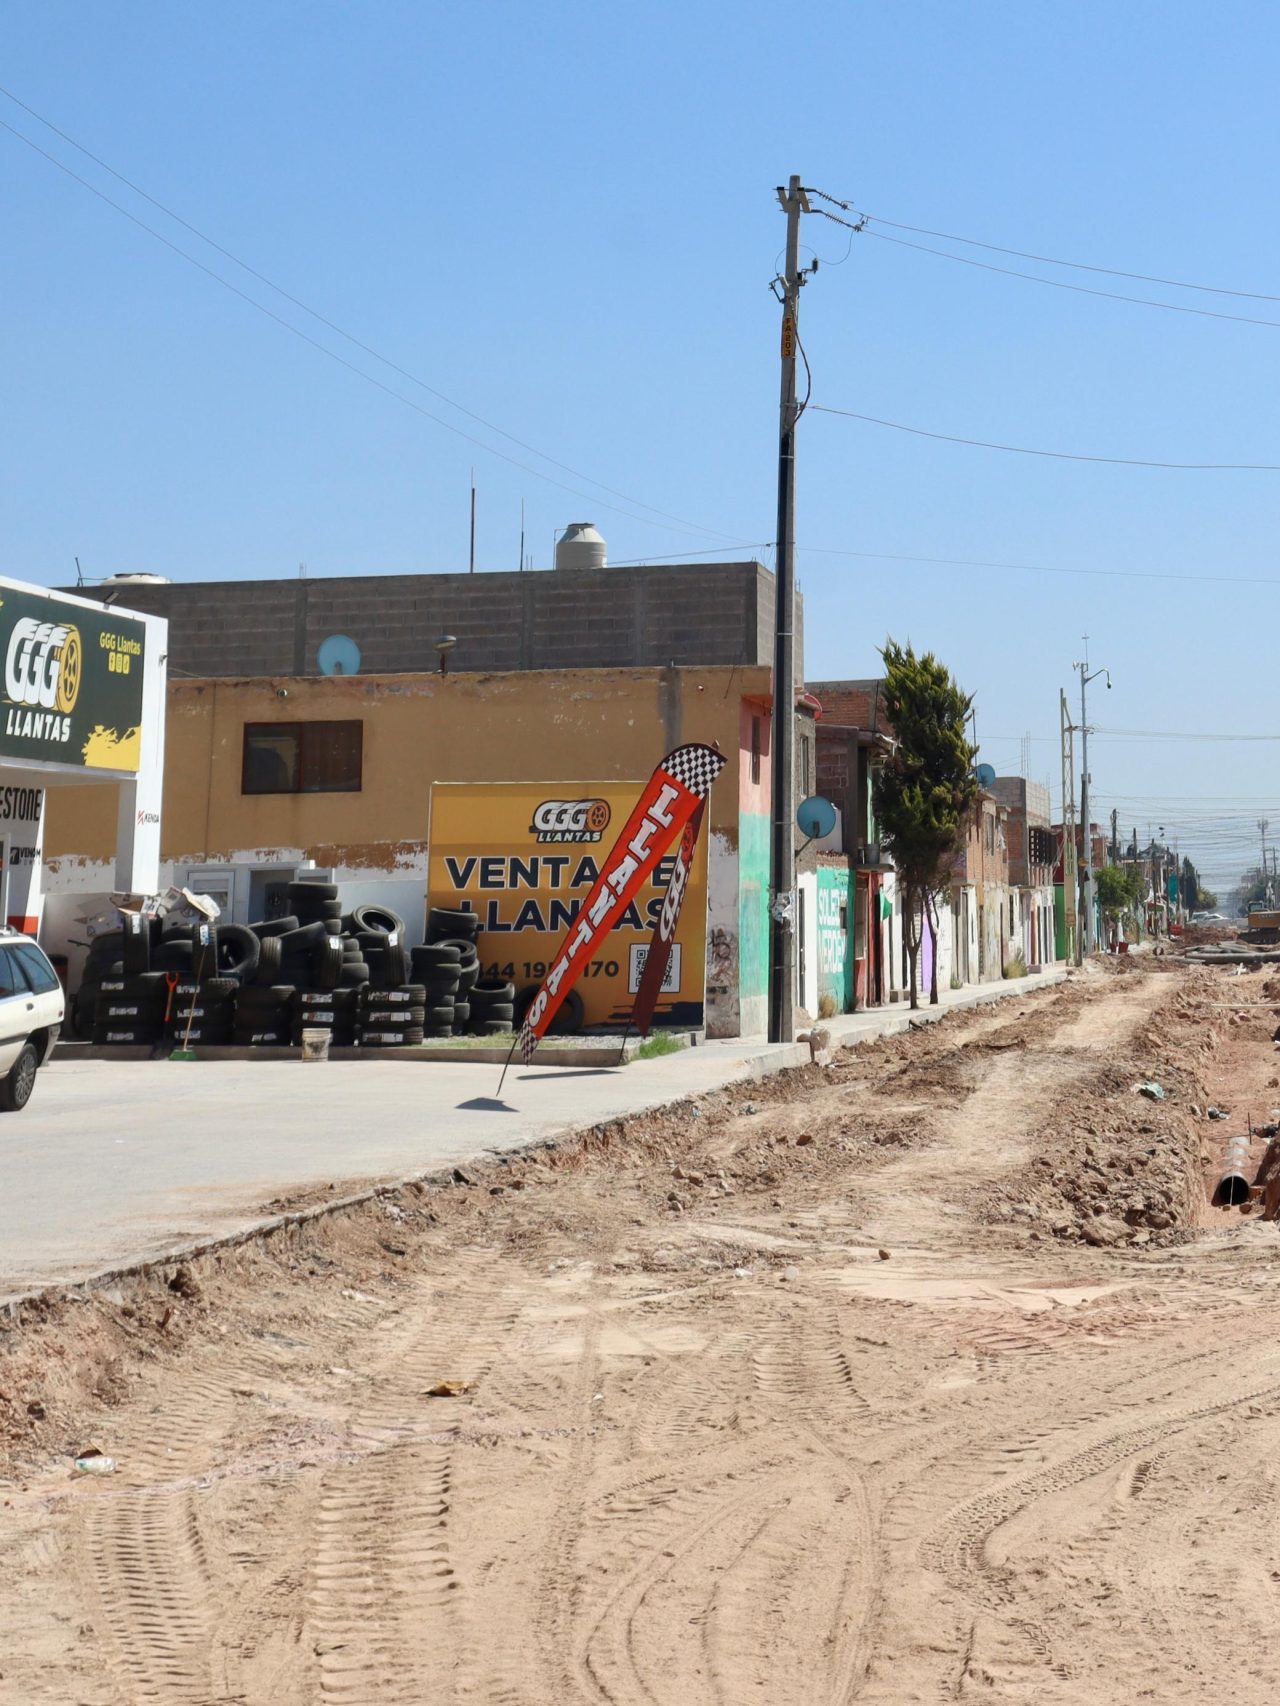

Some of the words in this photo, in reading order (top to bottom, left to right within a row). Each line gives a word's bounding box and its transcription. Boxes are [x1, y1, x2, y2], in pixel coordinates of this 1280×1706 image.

[99, 631, 116, 650] GGG
[116, 633, 141, 656] Llantas
[5, 616, 71, 709] GGG
[5, 708, 71, 743] LLANTAS
[533, 799, 596, 832] GGG
[536, 831, 603, 843] LLANTAS
[444, 855, 601, 890] VENTA
[528, 782, 680, 1028] LLANTAS
